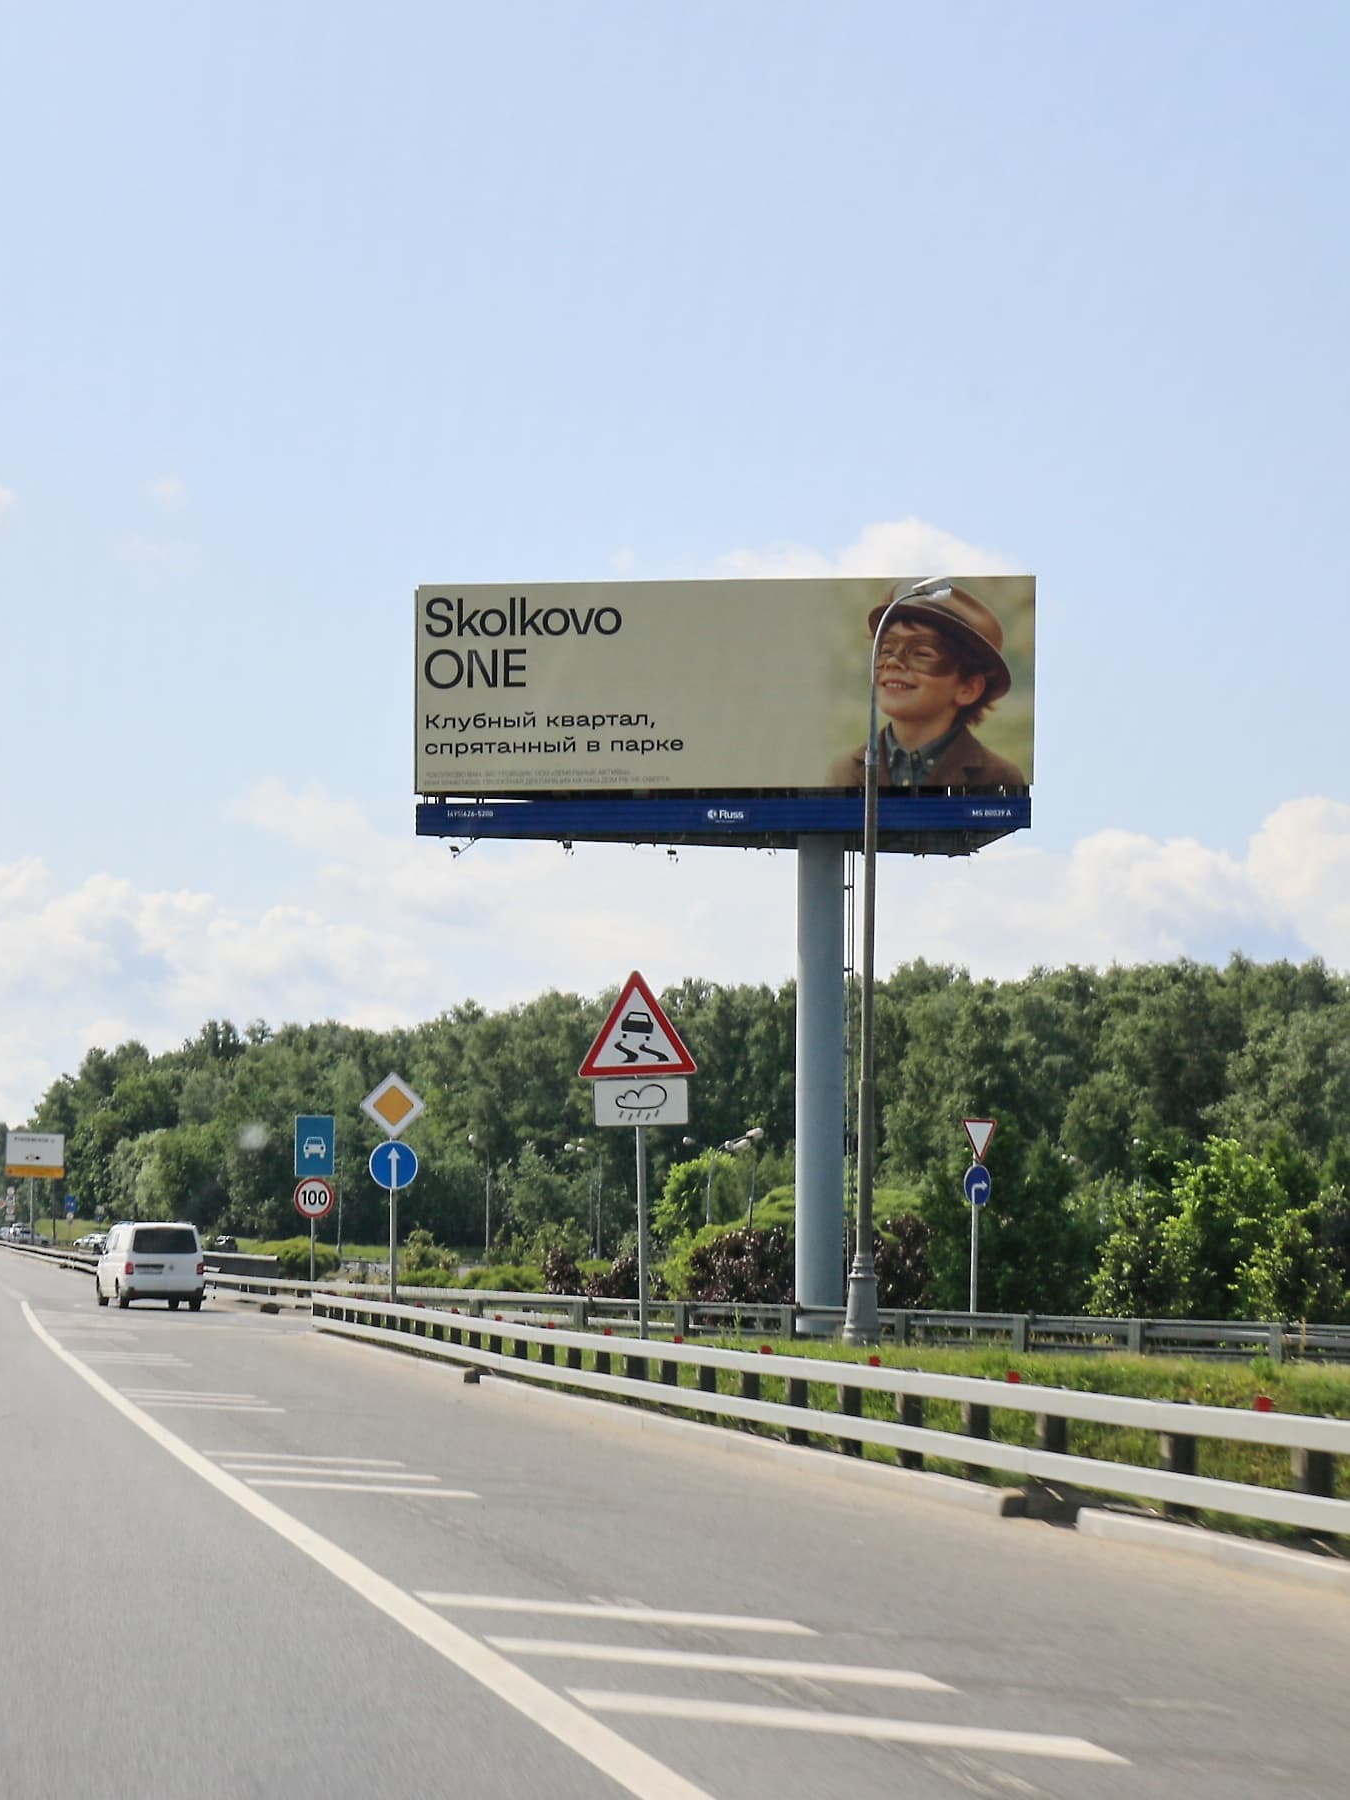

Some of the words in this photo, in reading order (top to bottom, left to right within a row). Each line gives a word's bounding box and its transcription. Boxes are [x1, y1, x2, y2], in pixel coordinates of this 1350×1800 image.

[425, 597, 622, 638] Skolkovo
[424, 648, 527, 689] ONE
[425, 711, 536, 733] Клубный
[546, 713, 656, 730] квартал,
[425, 736, 577, 758] спрятанный
[587, 739, 601, 752] в
[611, 738, 684, 755] парке
[719, 809, 745, 819] Russ
[301, 1190, 328, 1206] 100
